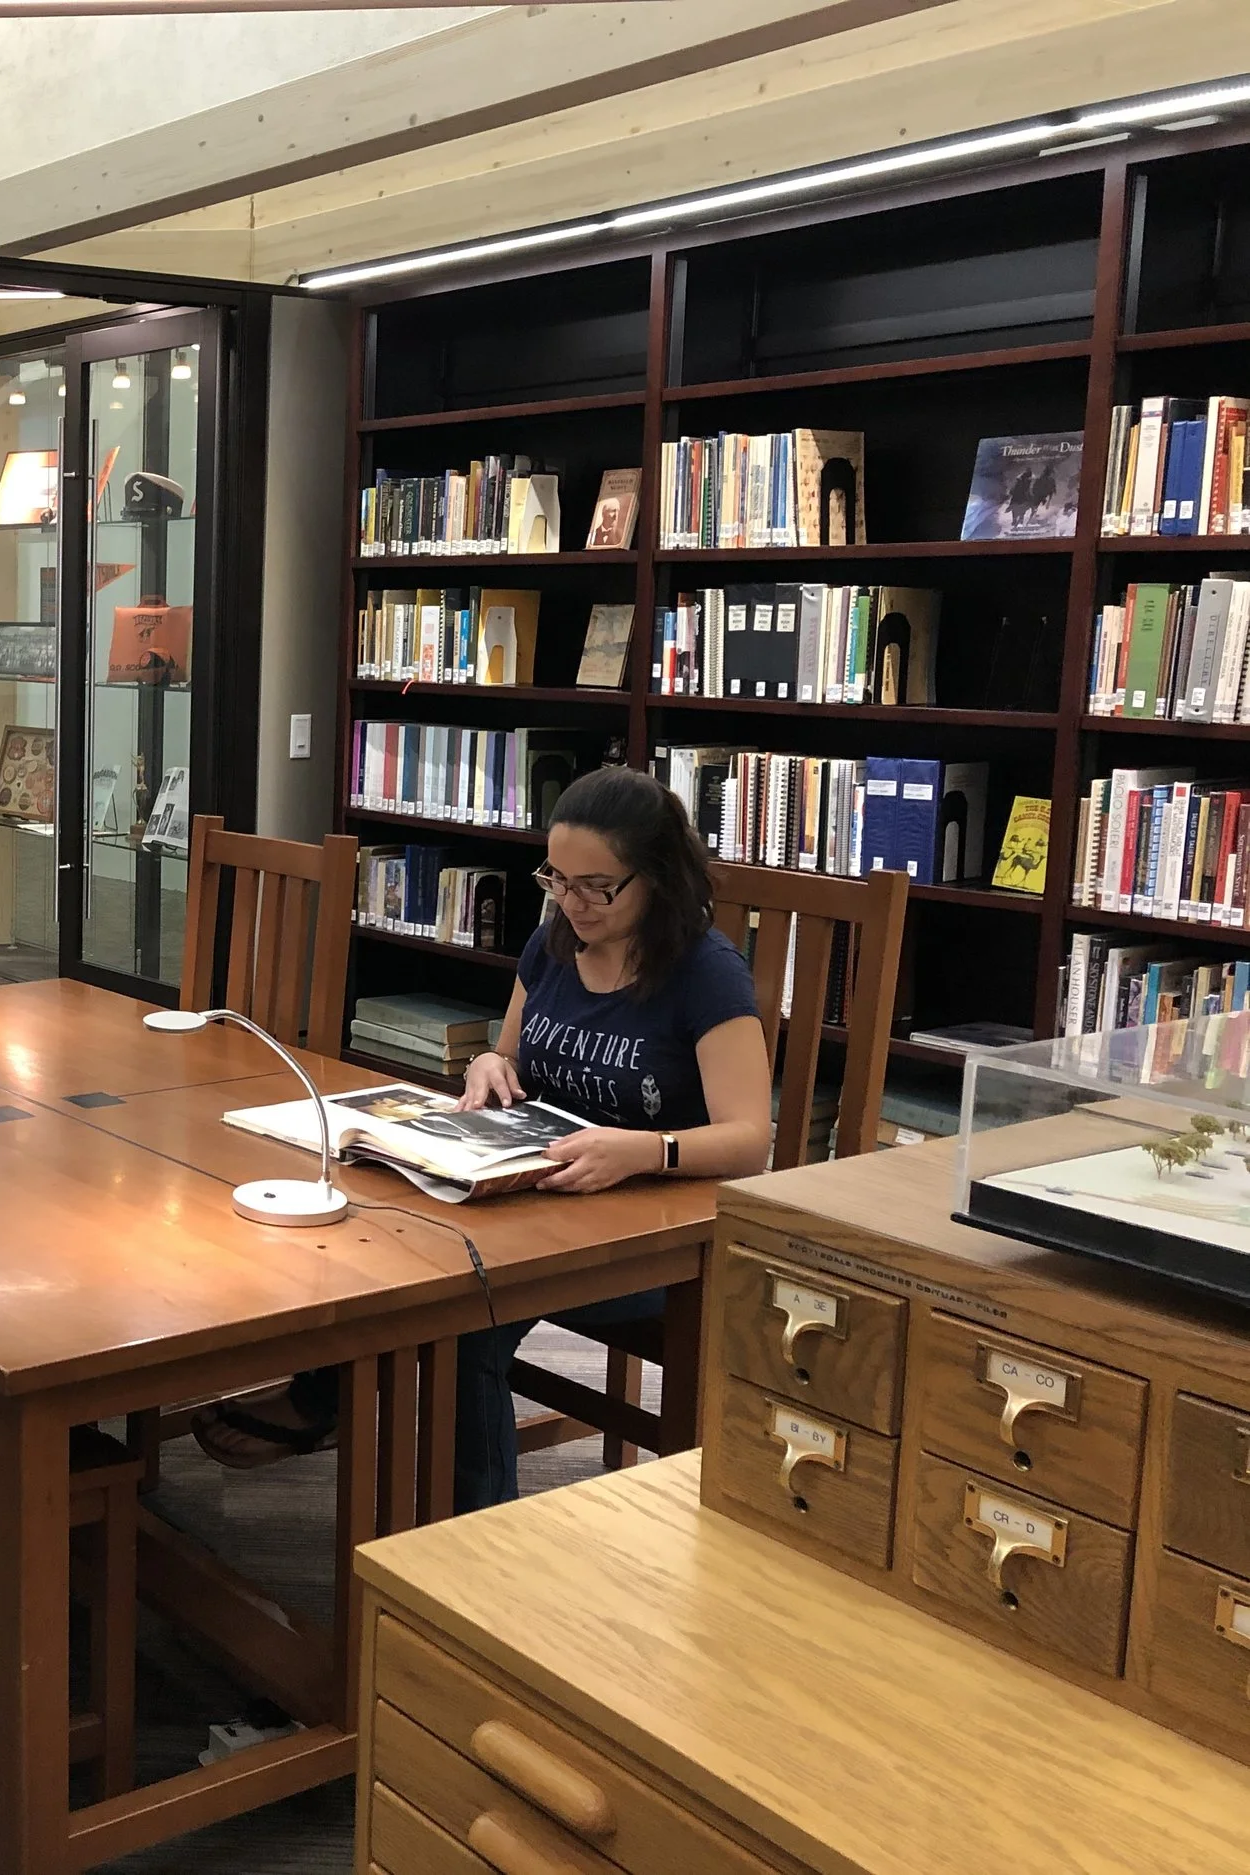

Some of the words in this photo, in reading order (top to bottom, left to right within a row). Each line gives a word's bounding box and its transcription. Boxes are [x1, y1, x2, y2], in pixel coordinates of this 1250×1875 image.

[1001, 444, 1042, 456] Thunder
[131, 481, 143, 502] S
[1113, 774, 1125, 809] PAOLO
[1110, 814, 1121, 849] SOLERI
[1190, 813, 1199, 828] TALES
[1187, 840, 1196, 865] TALIESIN
[1236, 834, 1245, 875] SOUTHWEST
[1072, 940, 1084, 974] ALLAN
[1068, 979, 1080, 1024] HOUSER
[522, 1013, 645, 1070] ADVENTURE
[530, 1059, 618, 1107] AWAITS
[788, 1240, 851, 1267] SCOTTSDALE
[916, 1283, 972, 1306] OBITUARY
[976, 1302, 1007, 1320] FILES
[793, 1294, 801, 1303] A
[1002, 1362, 1018, 1377] CA
[1035, 1374, 1054, 1388] CO
[790, 1422, 799, 1434] BI
[812, 1431, 826, 1444] BY
[993, 1510, 1010, 1524] CR
[1025, 1522, 1035, 1534] D
